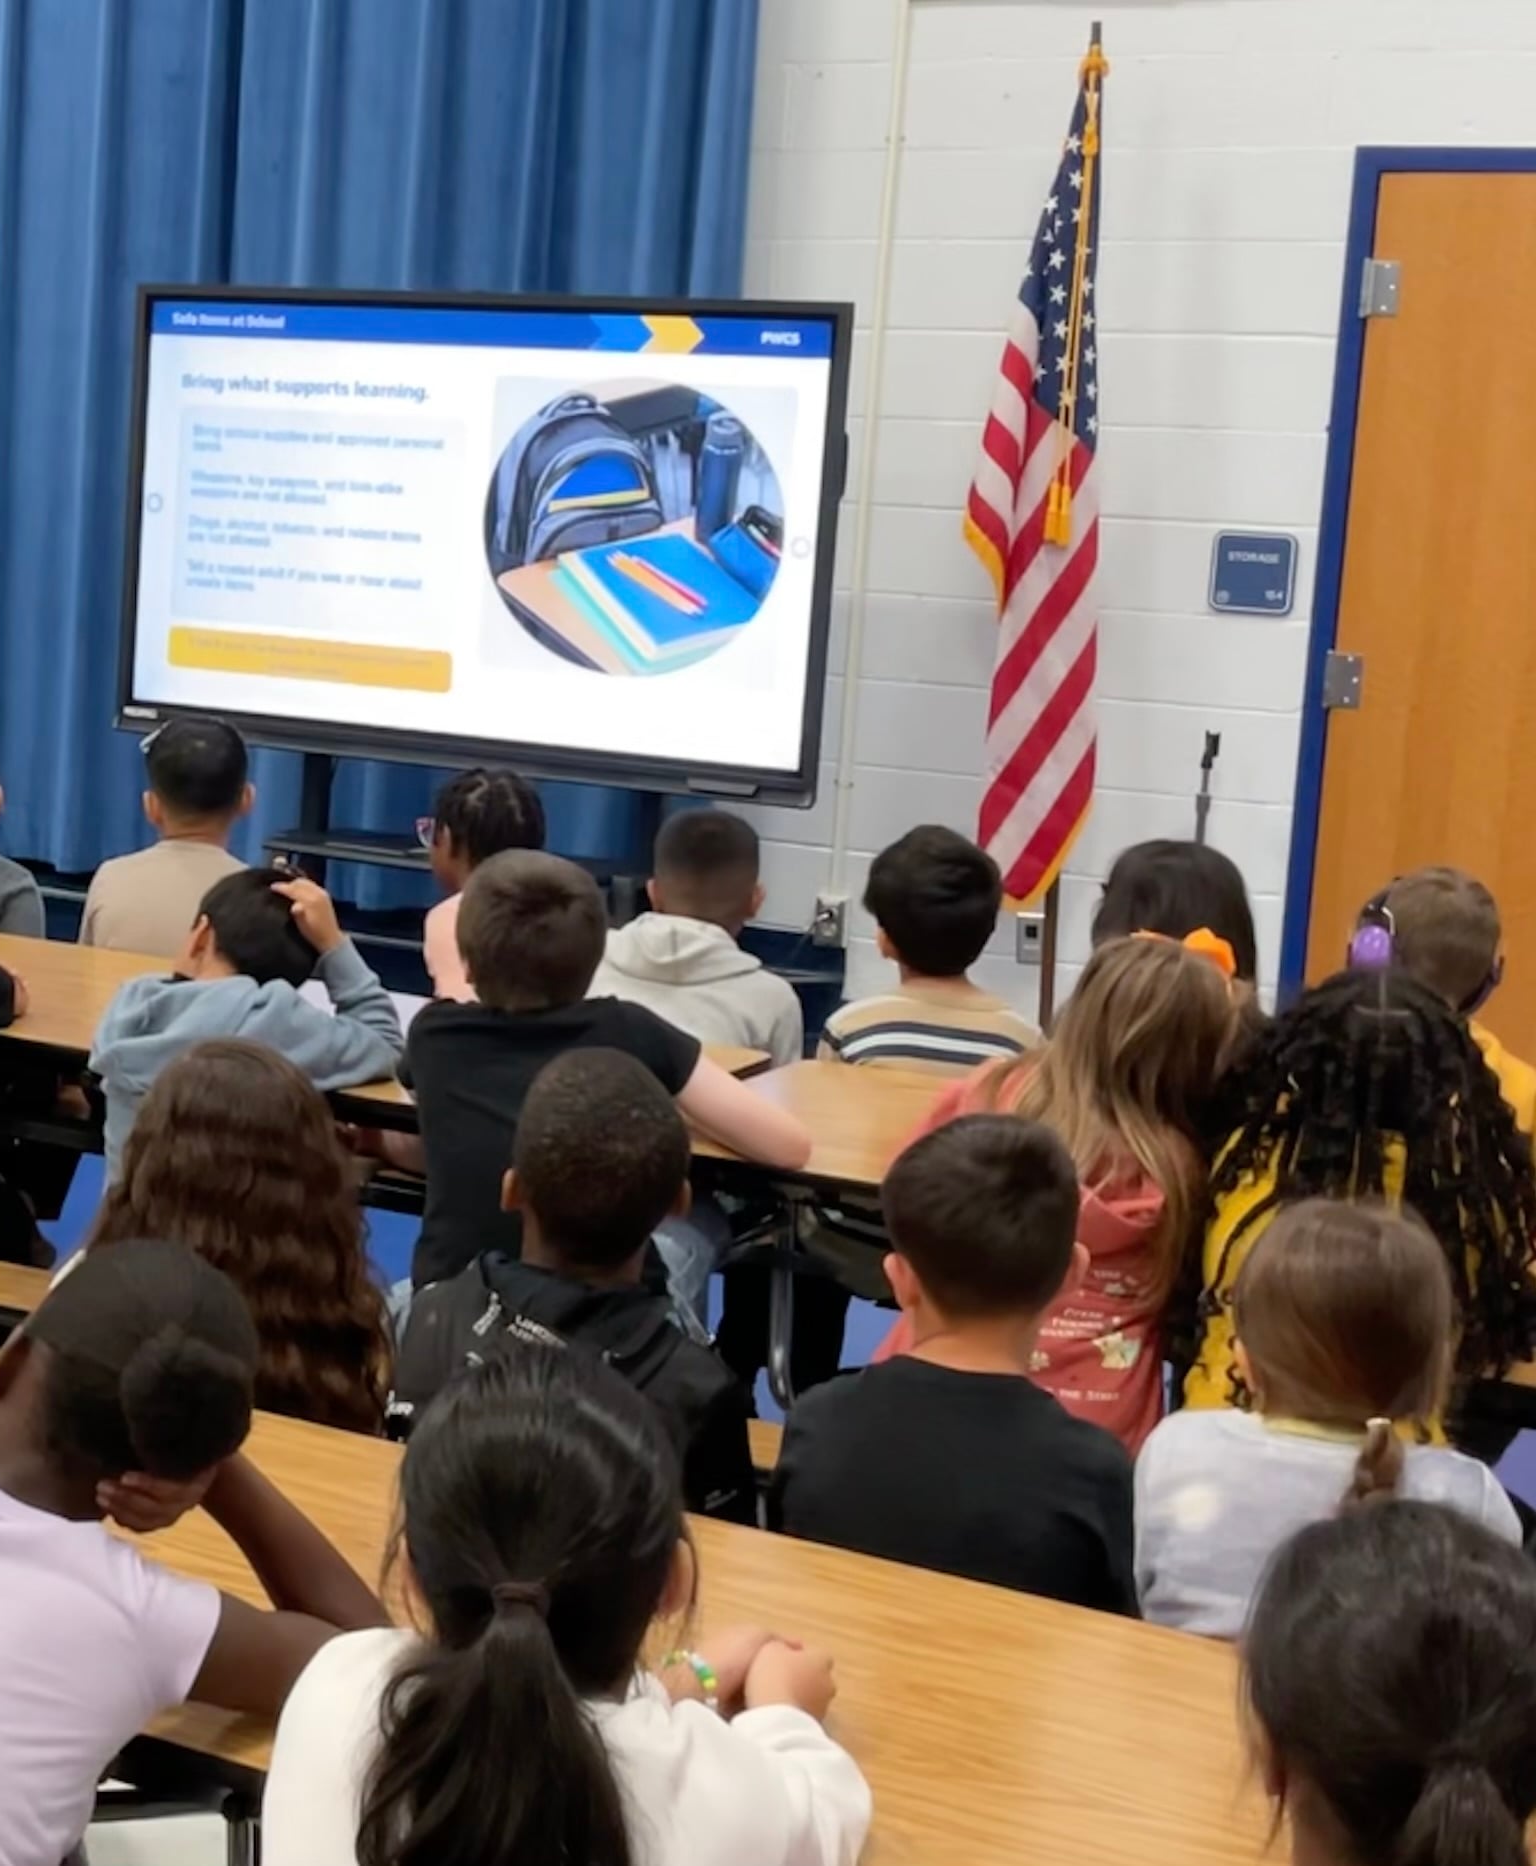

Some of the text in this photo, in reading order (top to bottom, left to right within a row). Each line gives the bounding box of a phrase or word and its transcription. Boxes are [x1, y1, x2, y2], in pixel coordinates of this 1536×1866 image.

[181, 374, 430, 403] Bring what supports learning.
